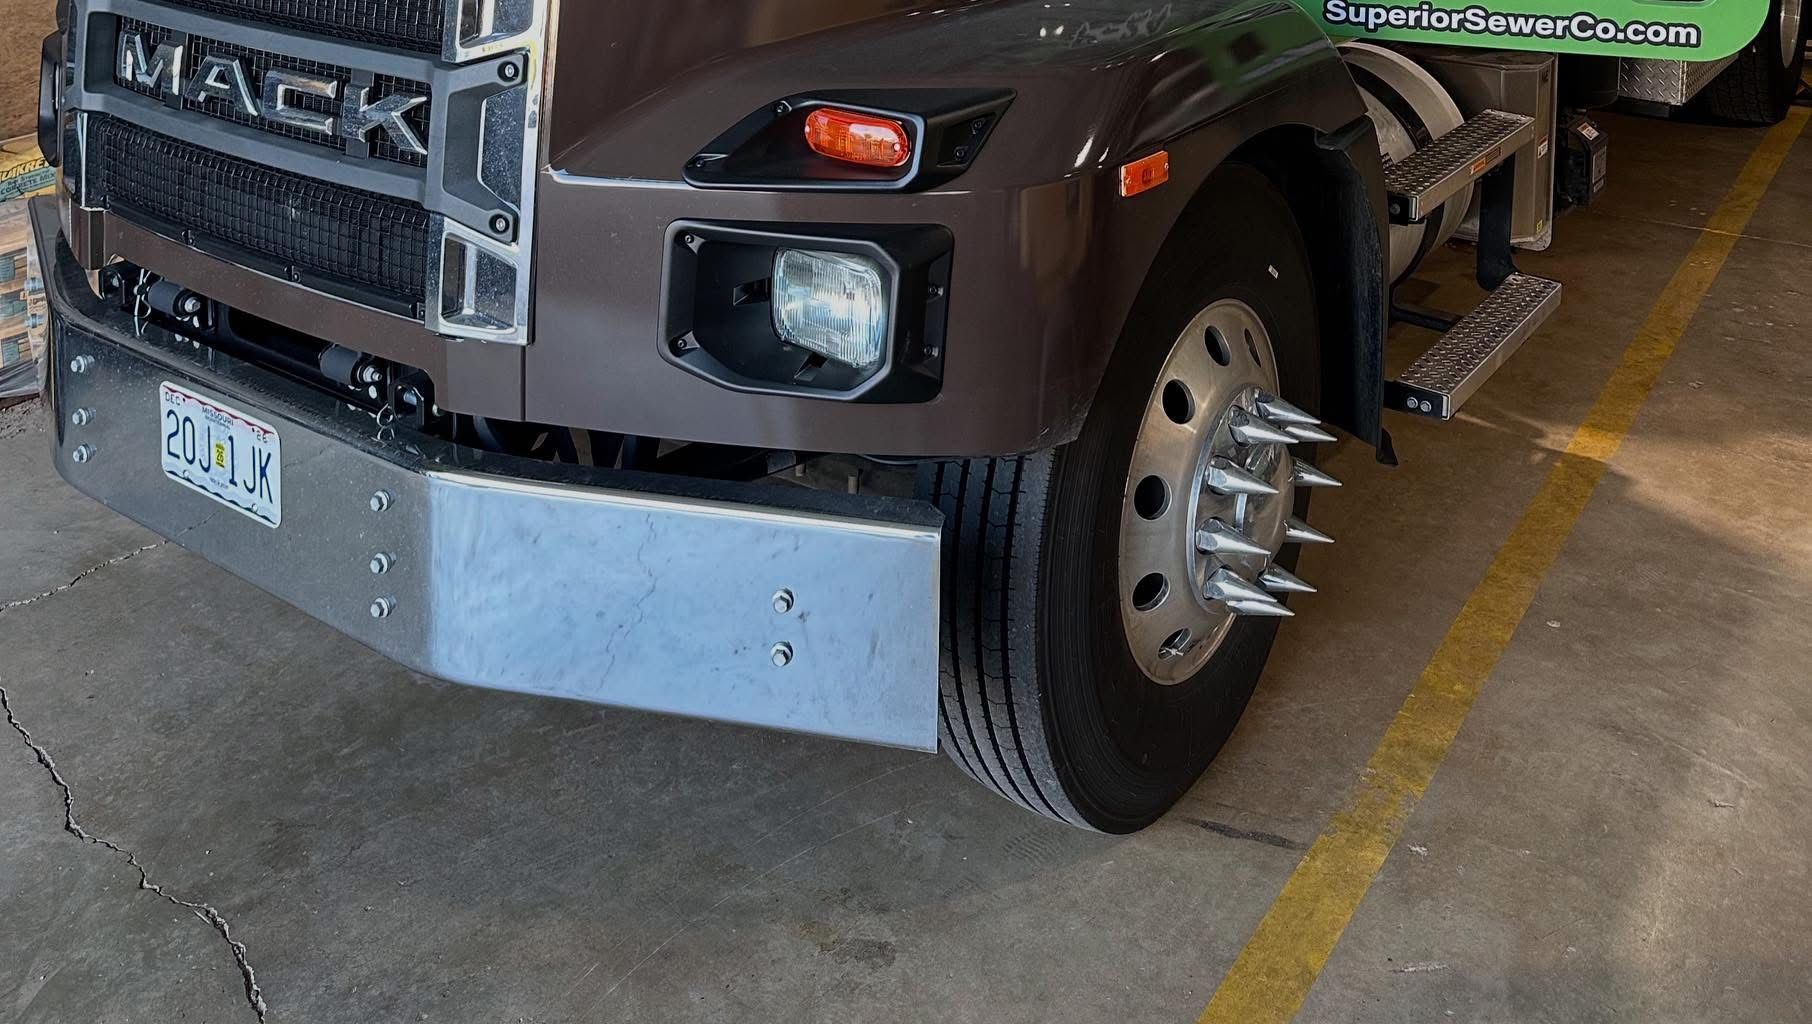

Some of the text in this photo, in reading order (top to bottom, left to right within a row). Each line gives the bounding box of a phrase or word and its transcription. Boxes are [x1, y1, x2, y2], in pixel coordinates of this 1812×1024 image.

[1325, 0, 1698, 45] SuperiorSewerCo.com
[115, 29, 428, 155] MACK
[165, 391, 181, 406] DEC
[202, 407, 234, 426] MISSOURI
[166, 409, 274, 505] 20J 1JK
